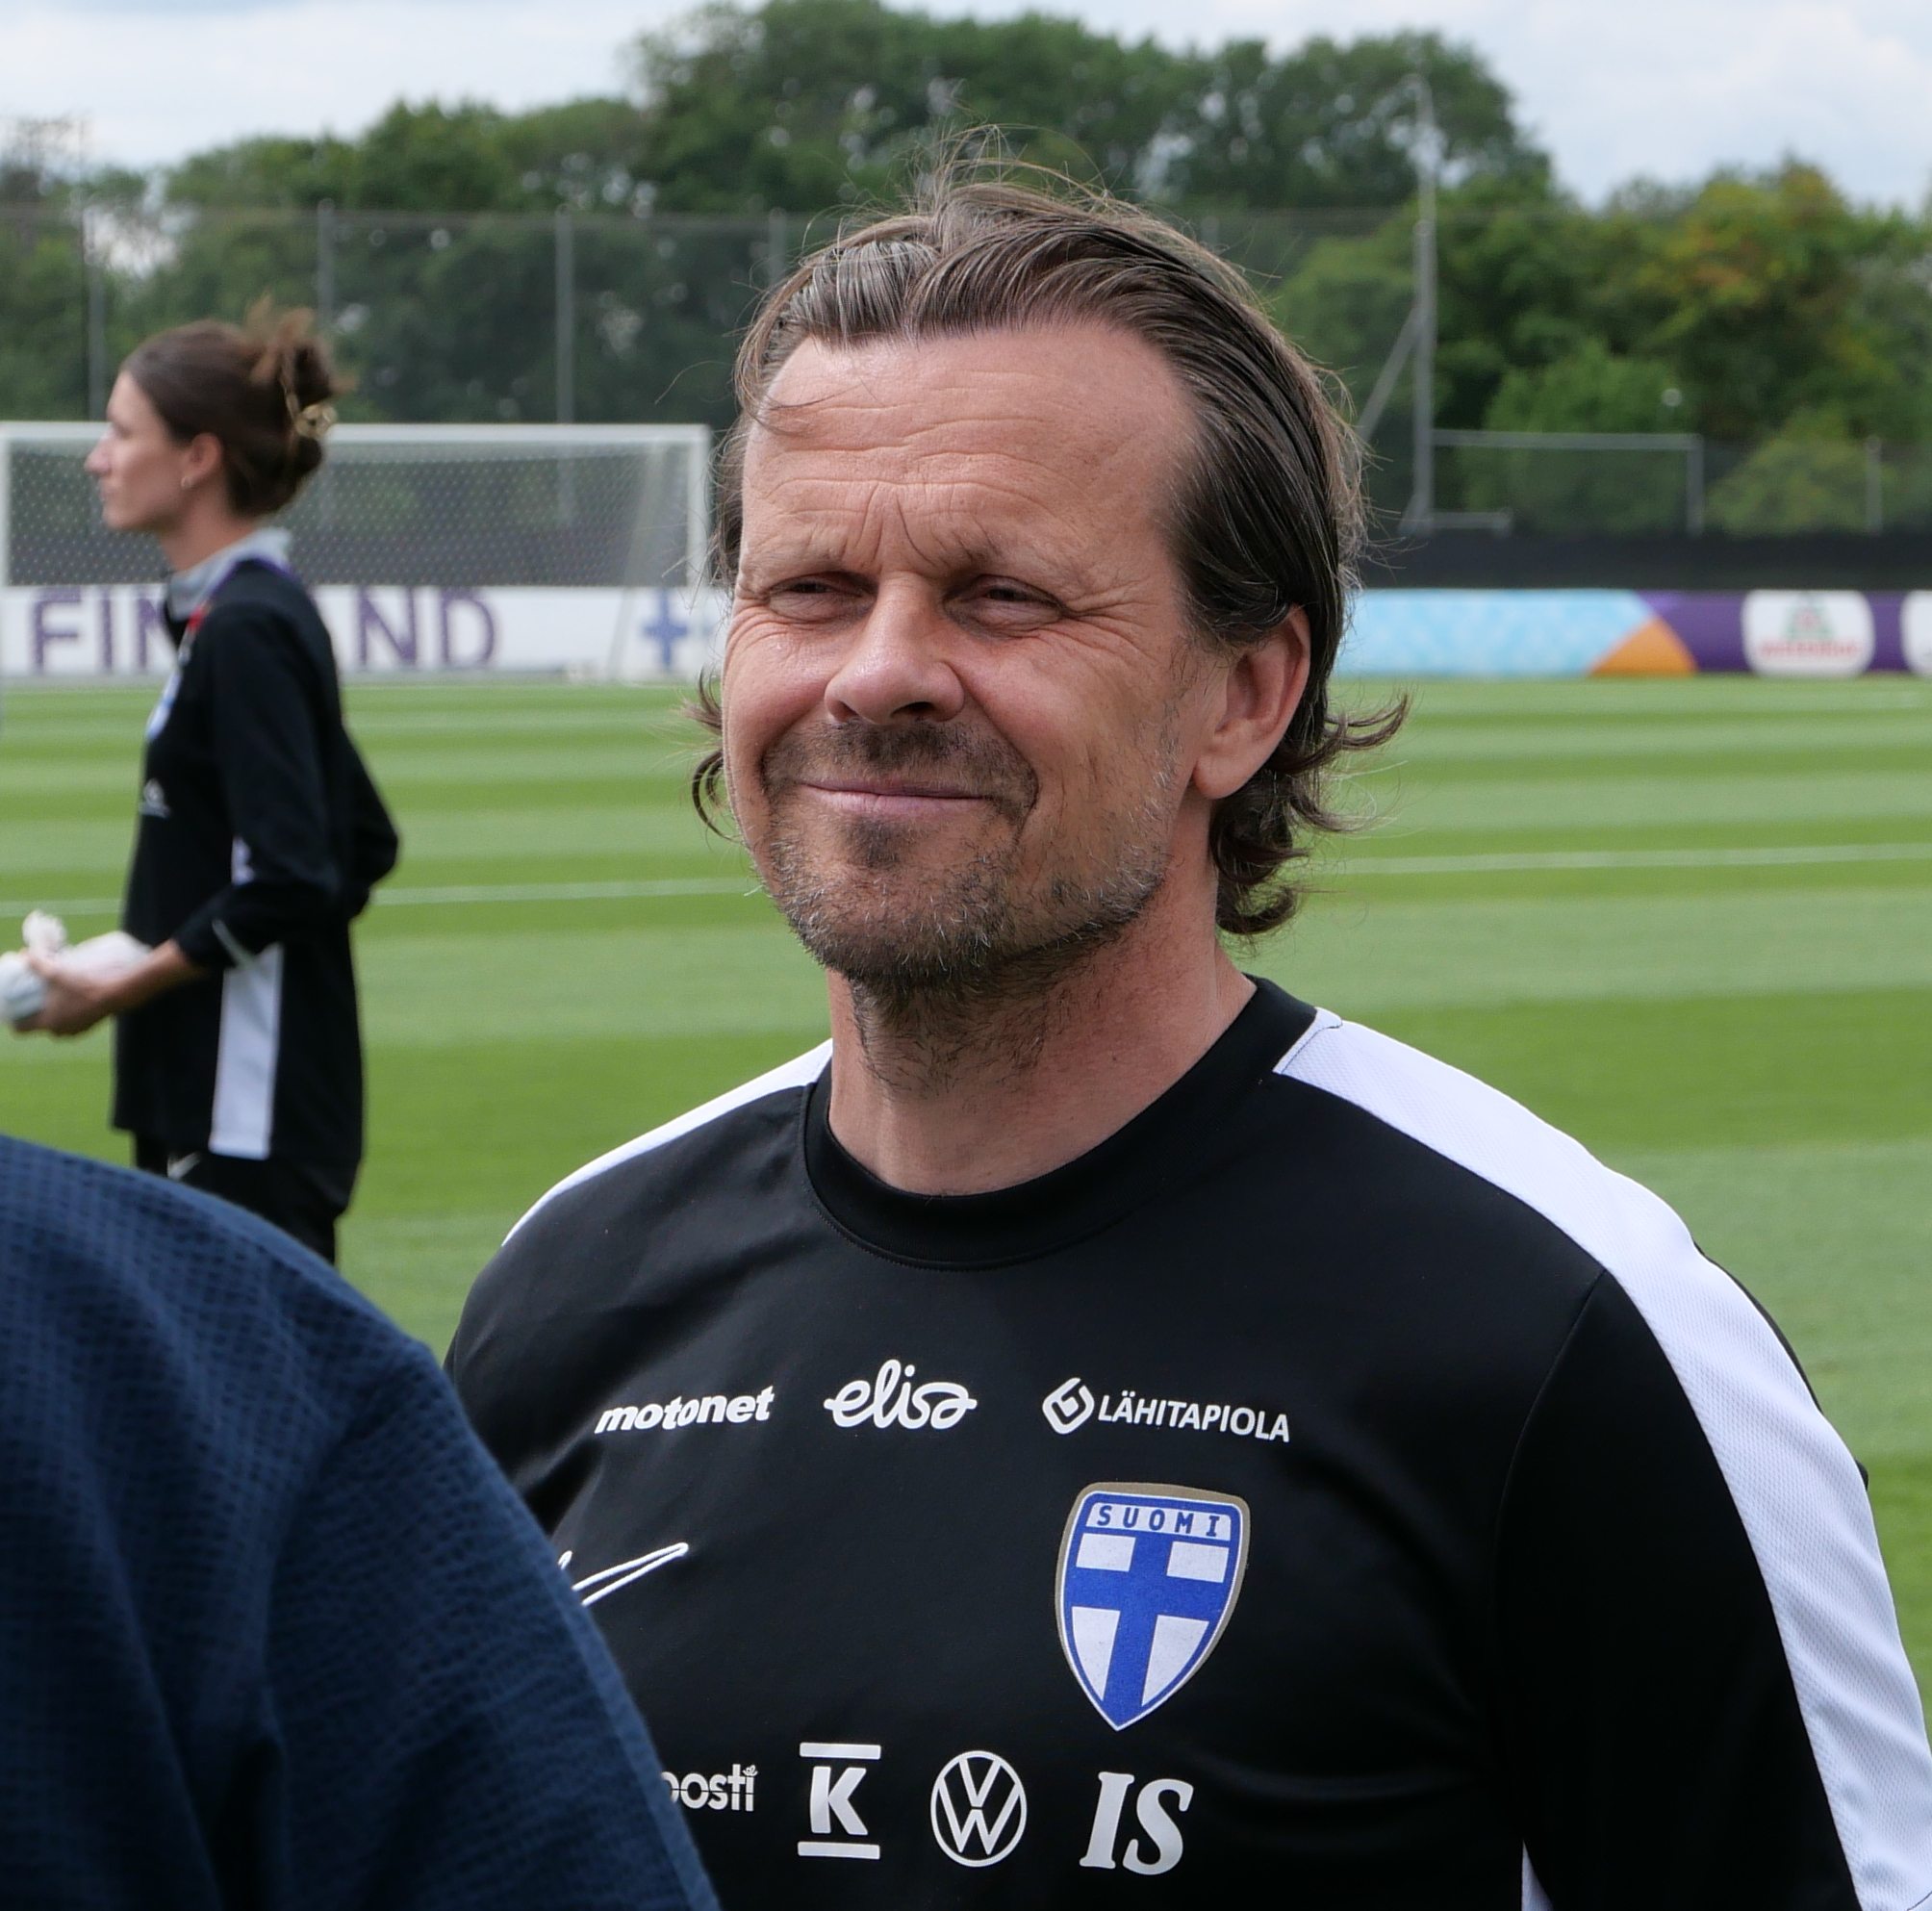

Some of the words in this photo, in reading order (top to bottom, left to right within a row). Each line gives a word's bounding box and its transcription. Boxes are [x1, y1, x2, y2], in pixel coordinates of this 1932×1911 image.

[594, 1386, 775, 1435] motonet
[823, 1359, 979, 1430] elisa
[1097, 1389, 1290, 1443] LÄHITAPIOLA
[1096, 1504, 1221, 1538] SUOMI
[809, 1765, 869, 1836] K
[1079, 1771, 1194, 1875] IS
